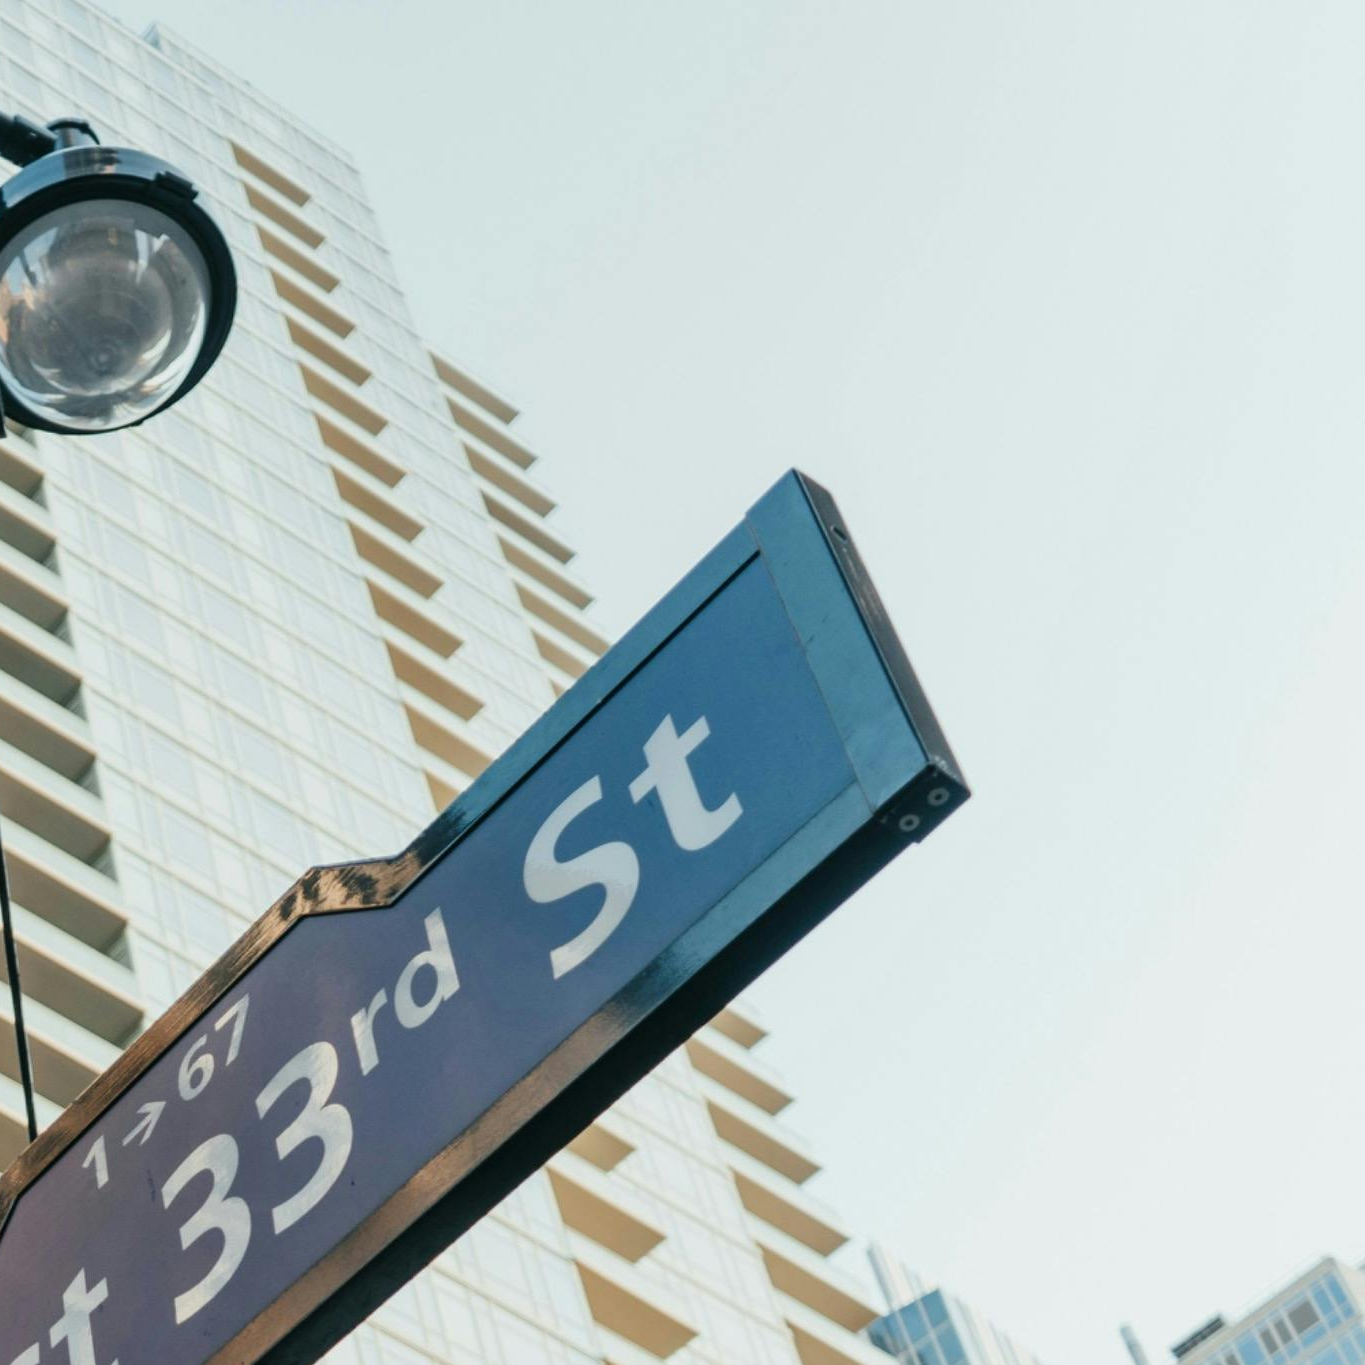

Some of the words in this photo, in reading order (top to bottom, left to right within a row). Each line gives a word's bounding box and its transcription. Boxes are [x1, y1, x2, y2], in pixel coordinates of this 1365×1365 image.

[81, 1133, 110, 1190] 1
[178, 993, 250, 1101] 67
[160, 907, 461, 1325] 33rd
[522, 713, 744, 981] St
